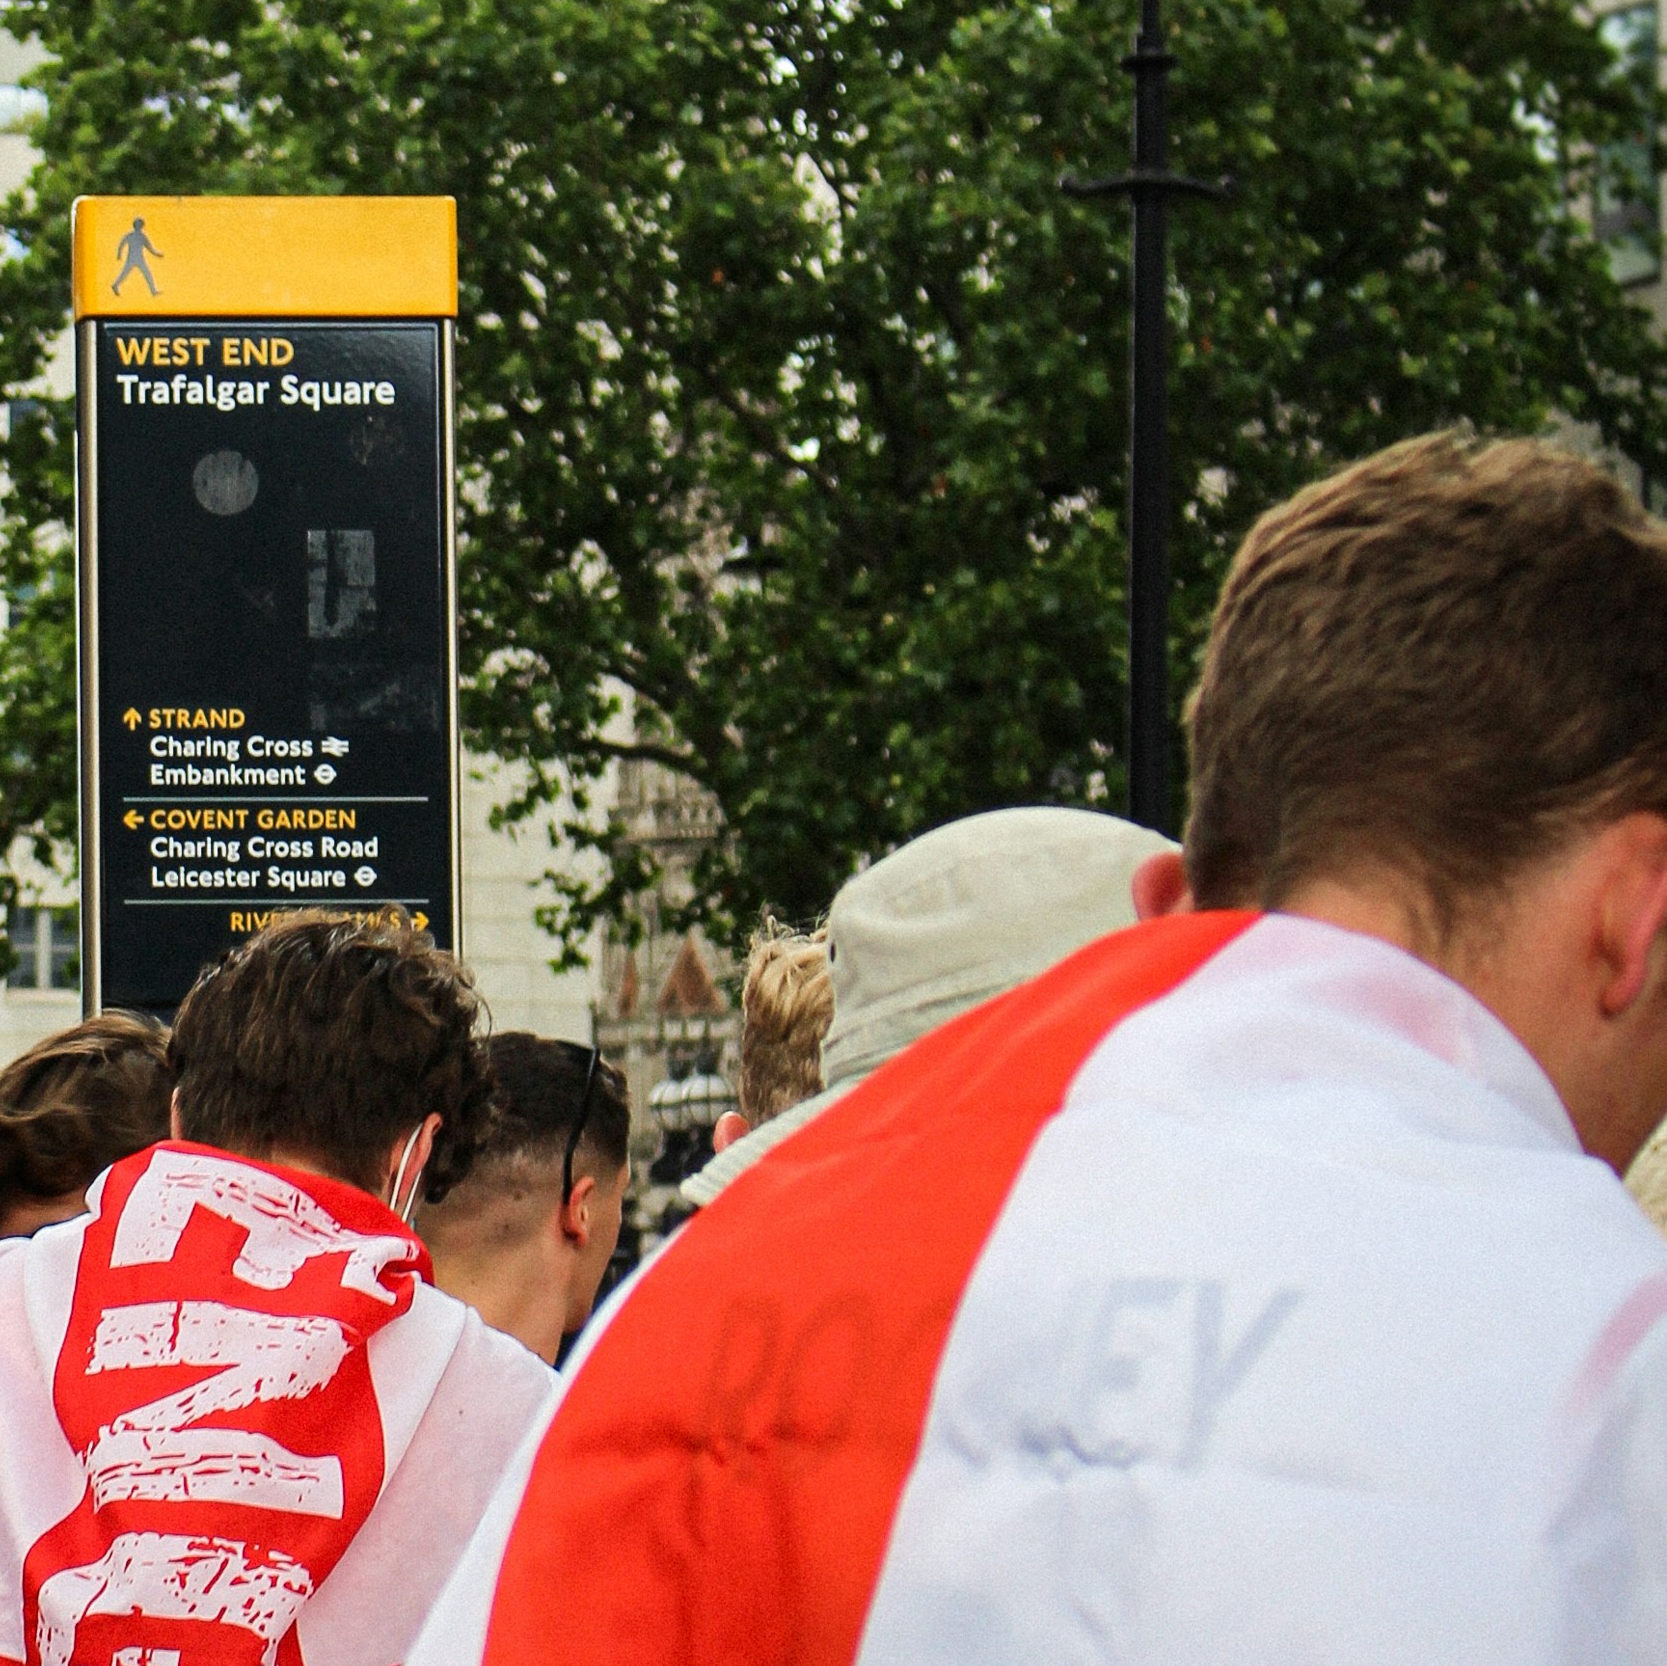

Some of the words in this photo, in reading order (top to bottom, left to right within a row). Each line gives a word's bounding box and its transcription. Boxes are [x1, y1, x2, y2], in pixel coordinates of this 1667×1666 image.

[116, 337, 211, 366] WEST
[222, 337, 295, 366] END
[116, 374, 270, 412] Trafalgar
[280, 374, 396, 412] Square
[149, 708, 245, 729] STRAND
[149, 735, 240, 762] Charing
[246, 735, 314, 758] Cross
[150, 763, 306, 785] Embankment
[150, 809, 249, 830] COVENT
[257, 809, 356, 830] GARDEN
[150, 836, 241, 862] Charing
[247, 836, 314, 858] Cross
[321, 836, 379, 858] Road
[151, 866, 261, 888] Leicester
[267, 865, 346, 892] Square
